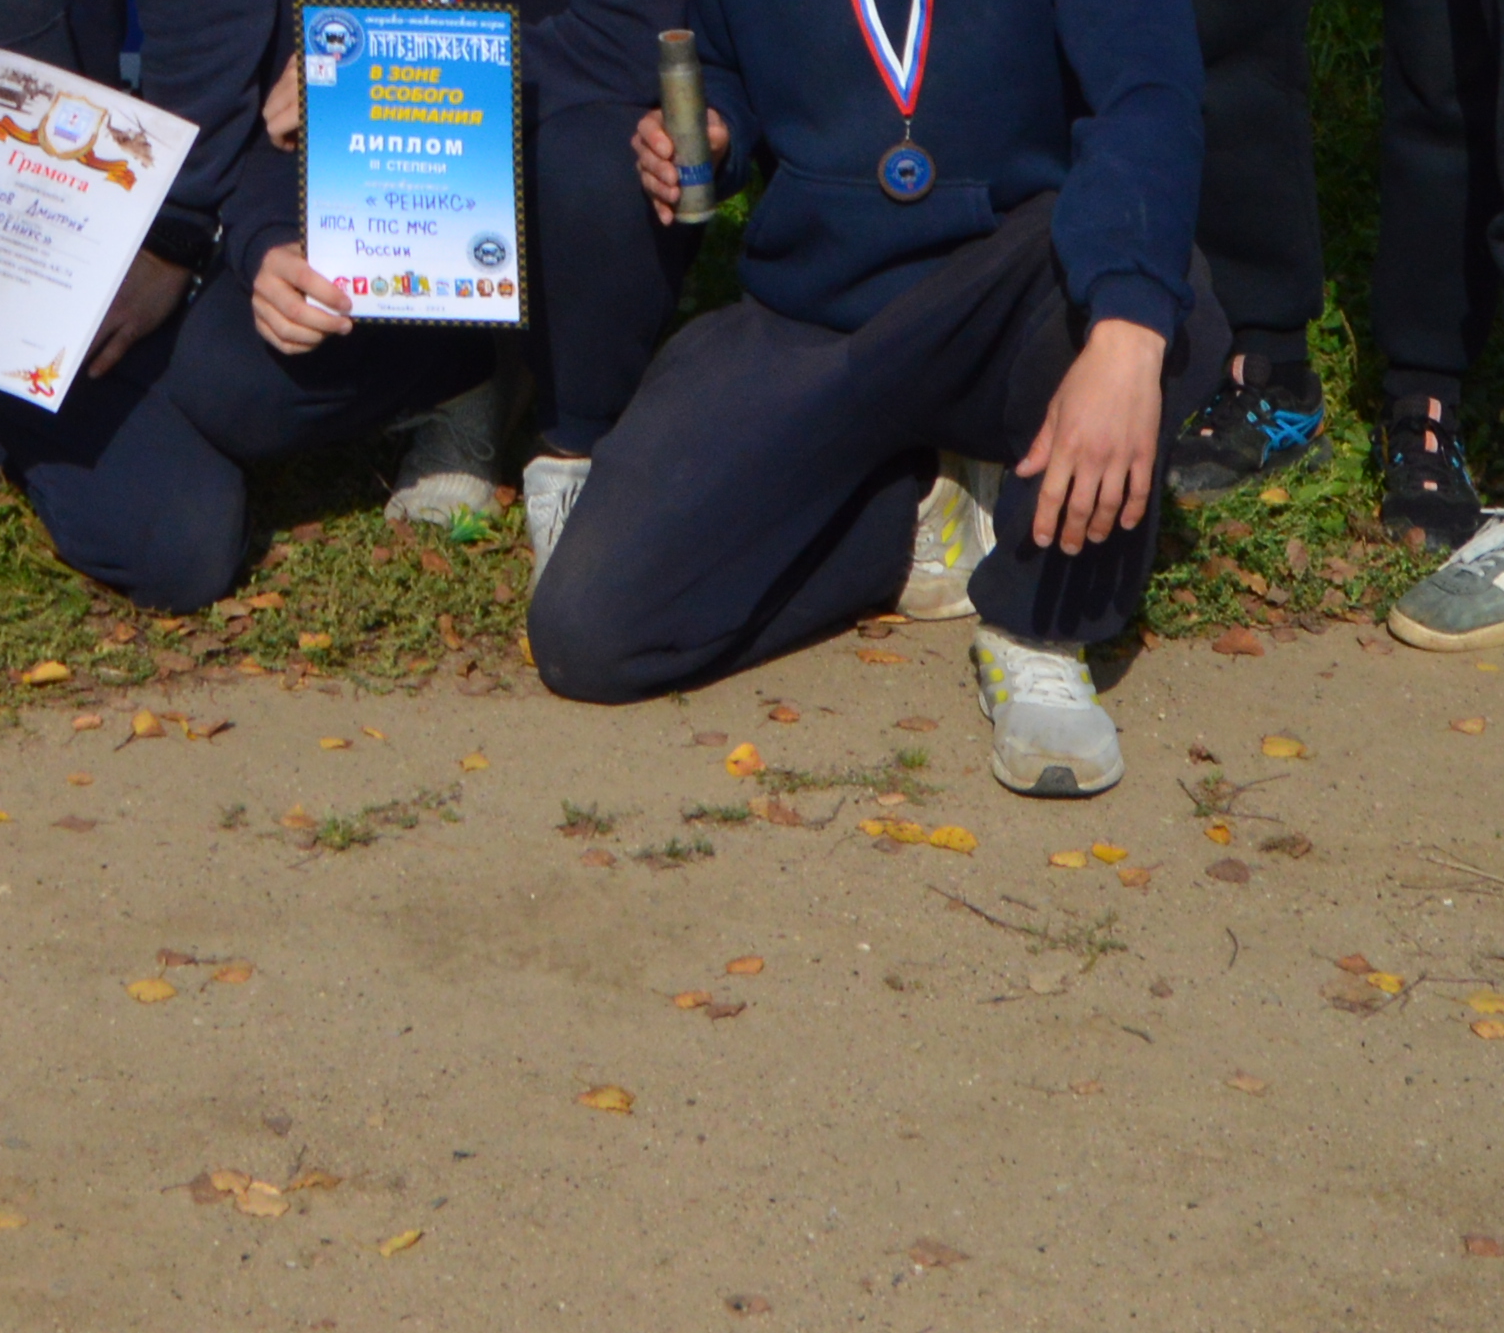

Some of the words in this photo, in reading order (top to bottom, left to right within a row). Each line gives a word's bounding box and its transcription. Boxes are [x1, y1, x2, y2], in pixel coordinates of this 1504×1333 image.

[369, 64, 383, 81] В
[388, 65, 442, 83] ЗОНЕ
[369, 84, 464, 105] ОСОБОГО
[369, 104, 484, 126] ВНИМАНИЯ
[348, 133, 464, 156] ДИПЛОМ
[8, 149, 90, 193] Грамота
[386, 159, 448, 175] СТЕПЕНИ
[406, 220, 439, 236] МЧС
